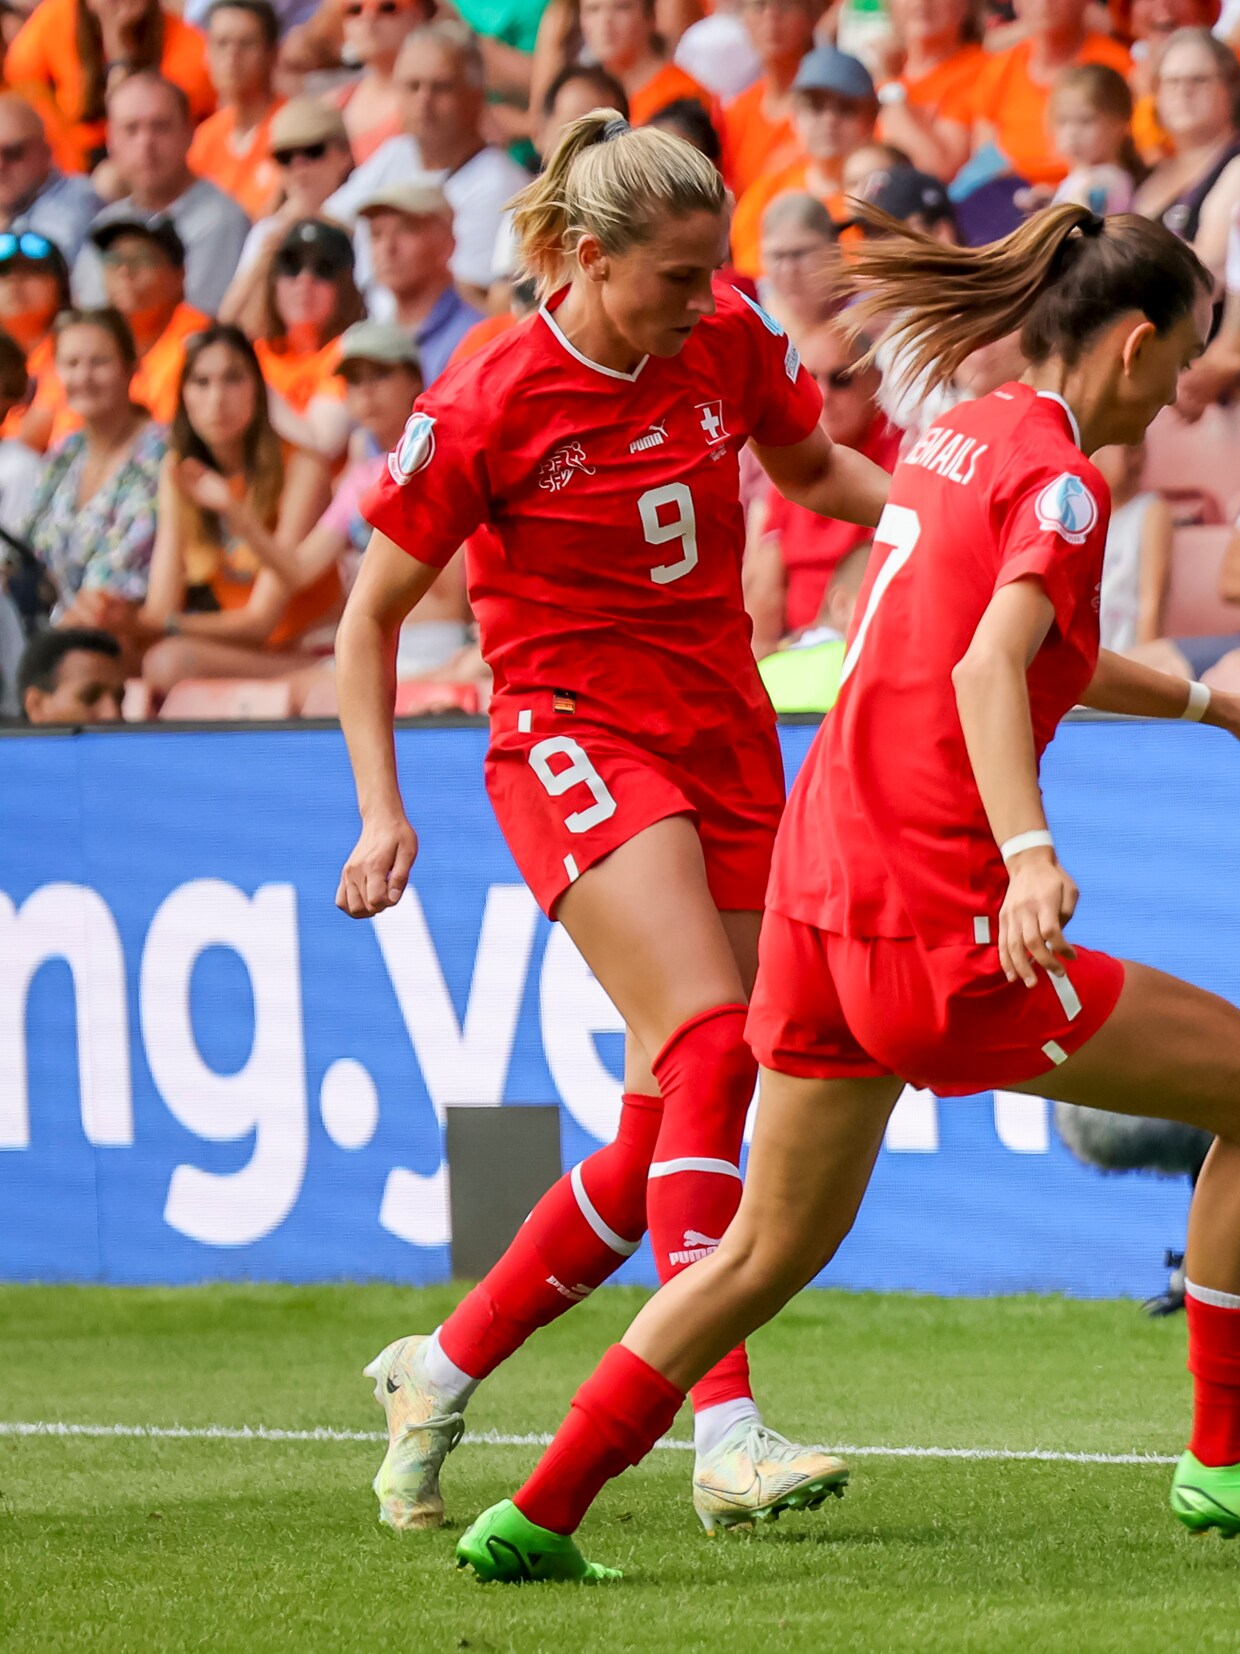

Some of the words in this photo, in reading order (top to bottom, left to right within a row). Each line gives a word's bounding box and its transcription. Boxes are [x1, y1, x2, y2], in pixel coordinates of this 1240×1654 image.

[629, 432, 664, 454] PUMA
[637, 481, 699, 585] 9
[839, 503, 922, 689] 7
[527, 735, 617, 834] 9
[545, 1274, 587, 1300] PUM
